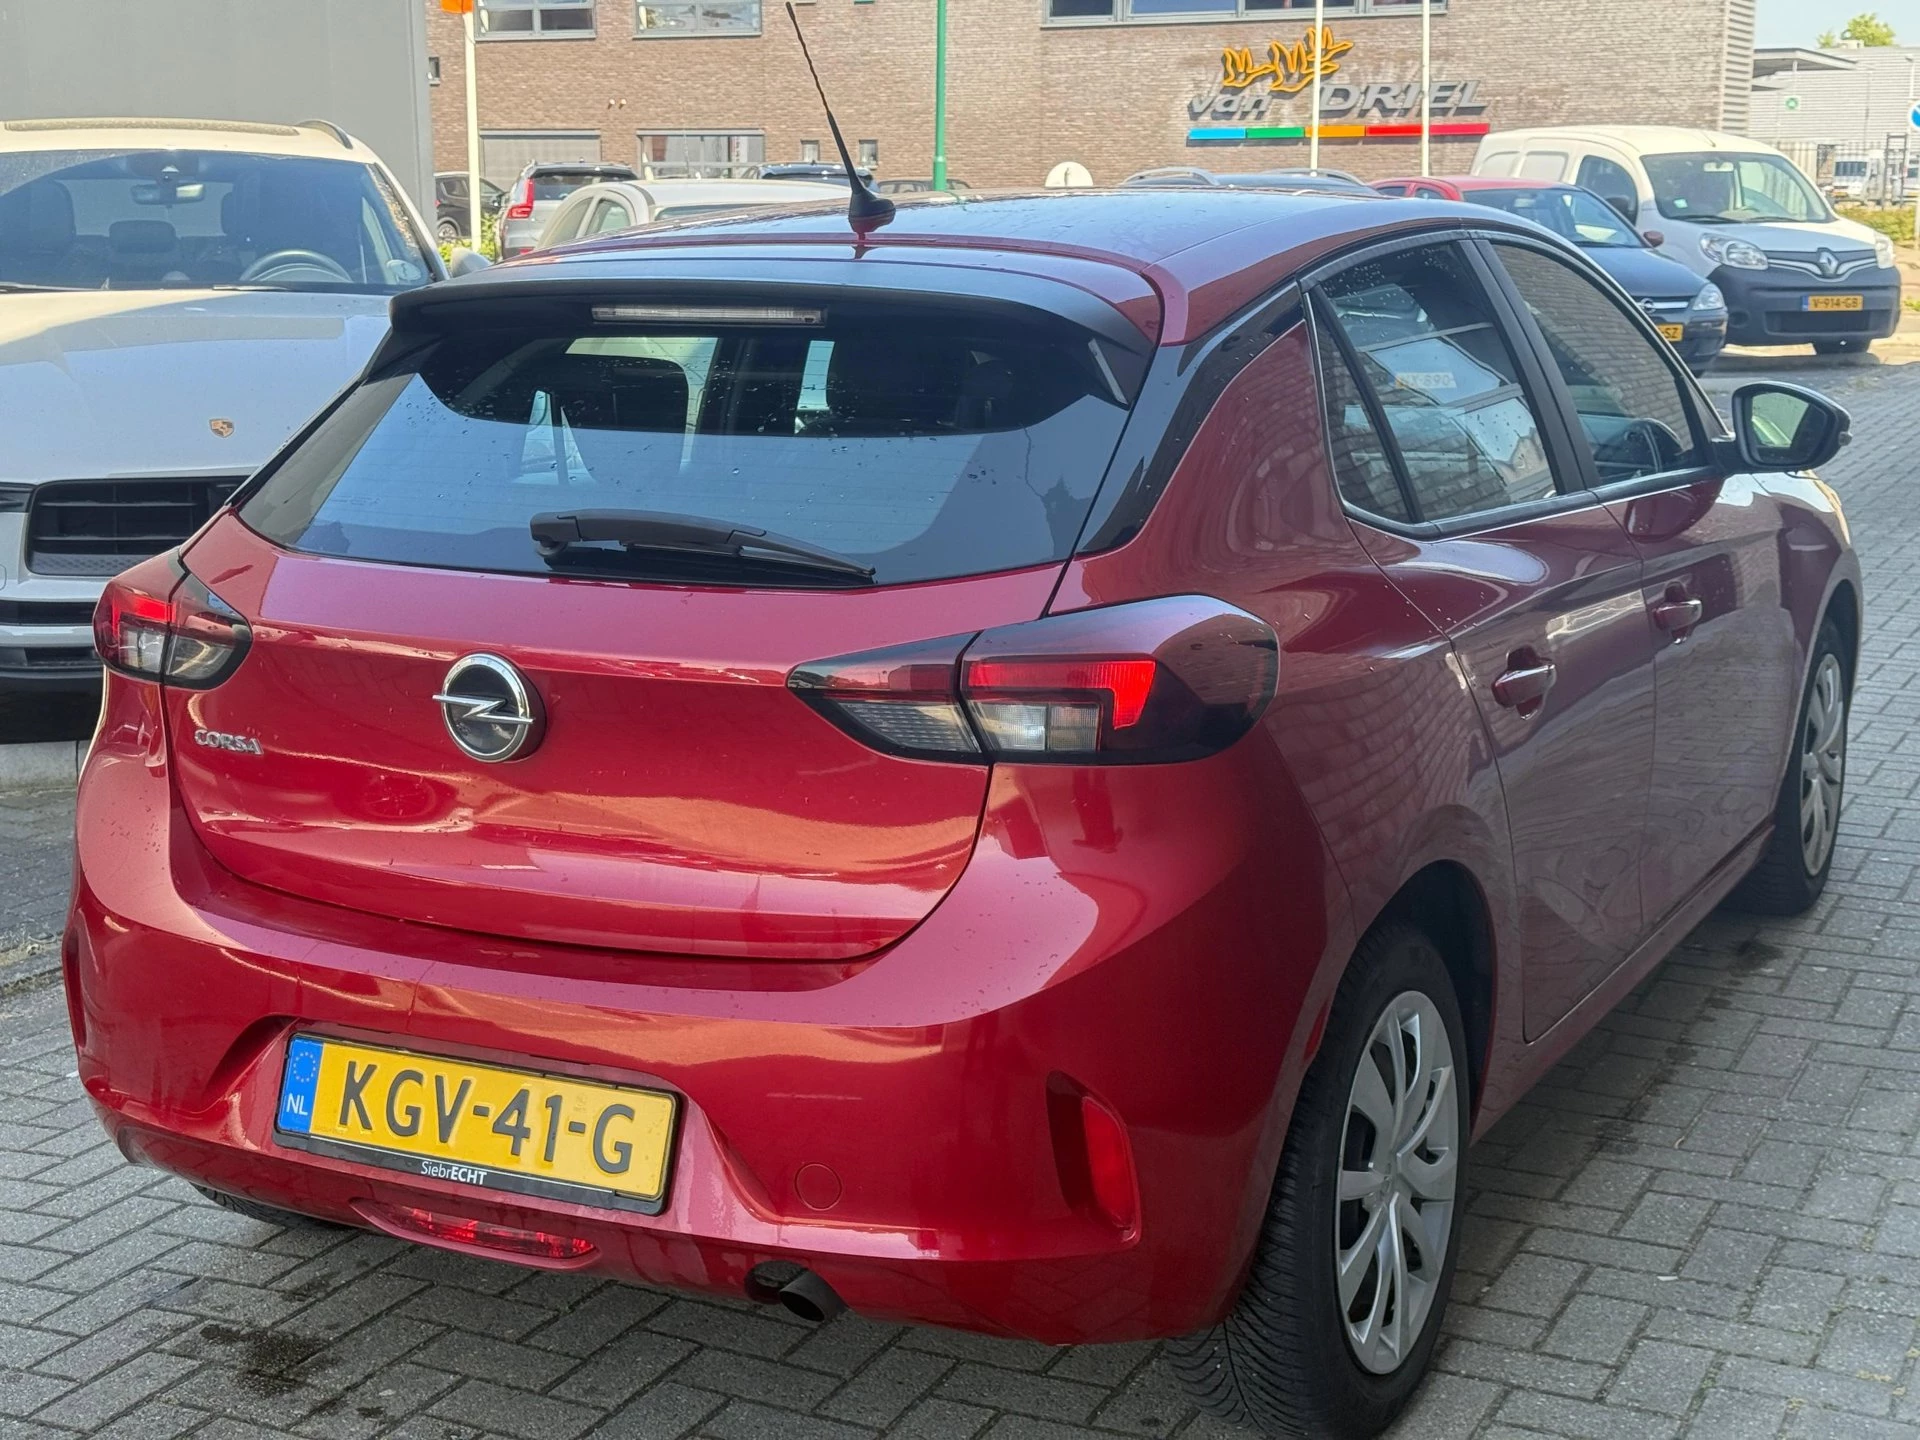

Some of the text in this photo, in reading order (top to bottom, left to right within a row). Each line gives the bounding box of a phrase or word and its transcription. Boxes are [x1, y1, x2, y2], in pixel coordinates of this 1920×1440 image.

[1190, 80, 1489, 113] van DRIEL
[194, 729, 263, 755] CORSA
[286, 1092, 308, 1116] NL
[338, 1060, 636, 1175] KGV-41-G
[420, 1160, 488, 1186] SiebrECHT
